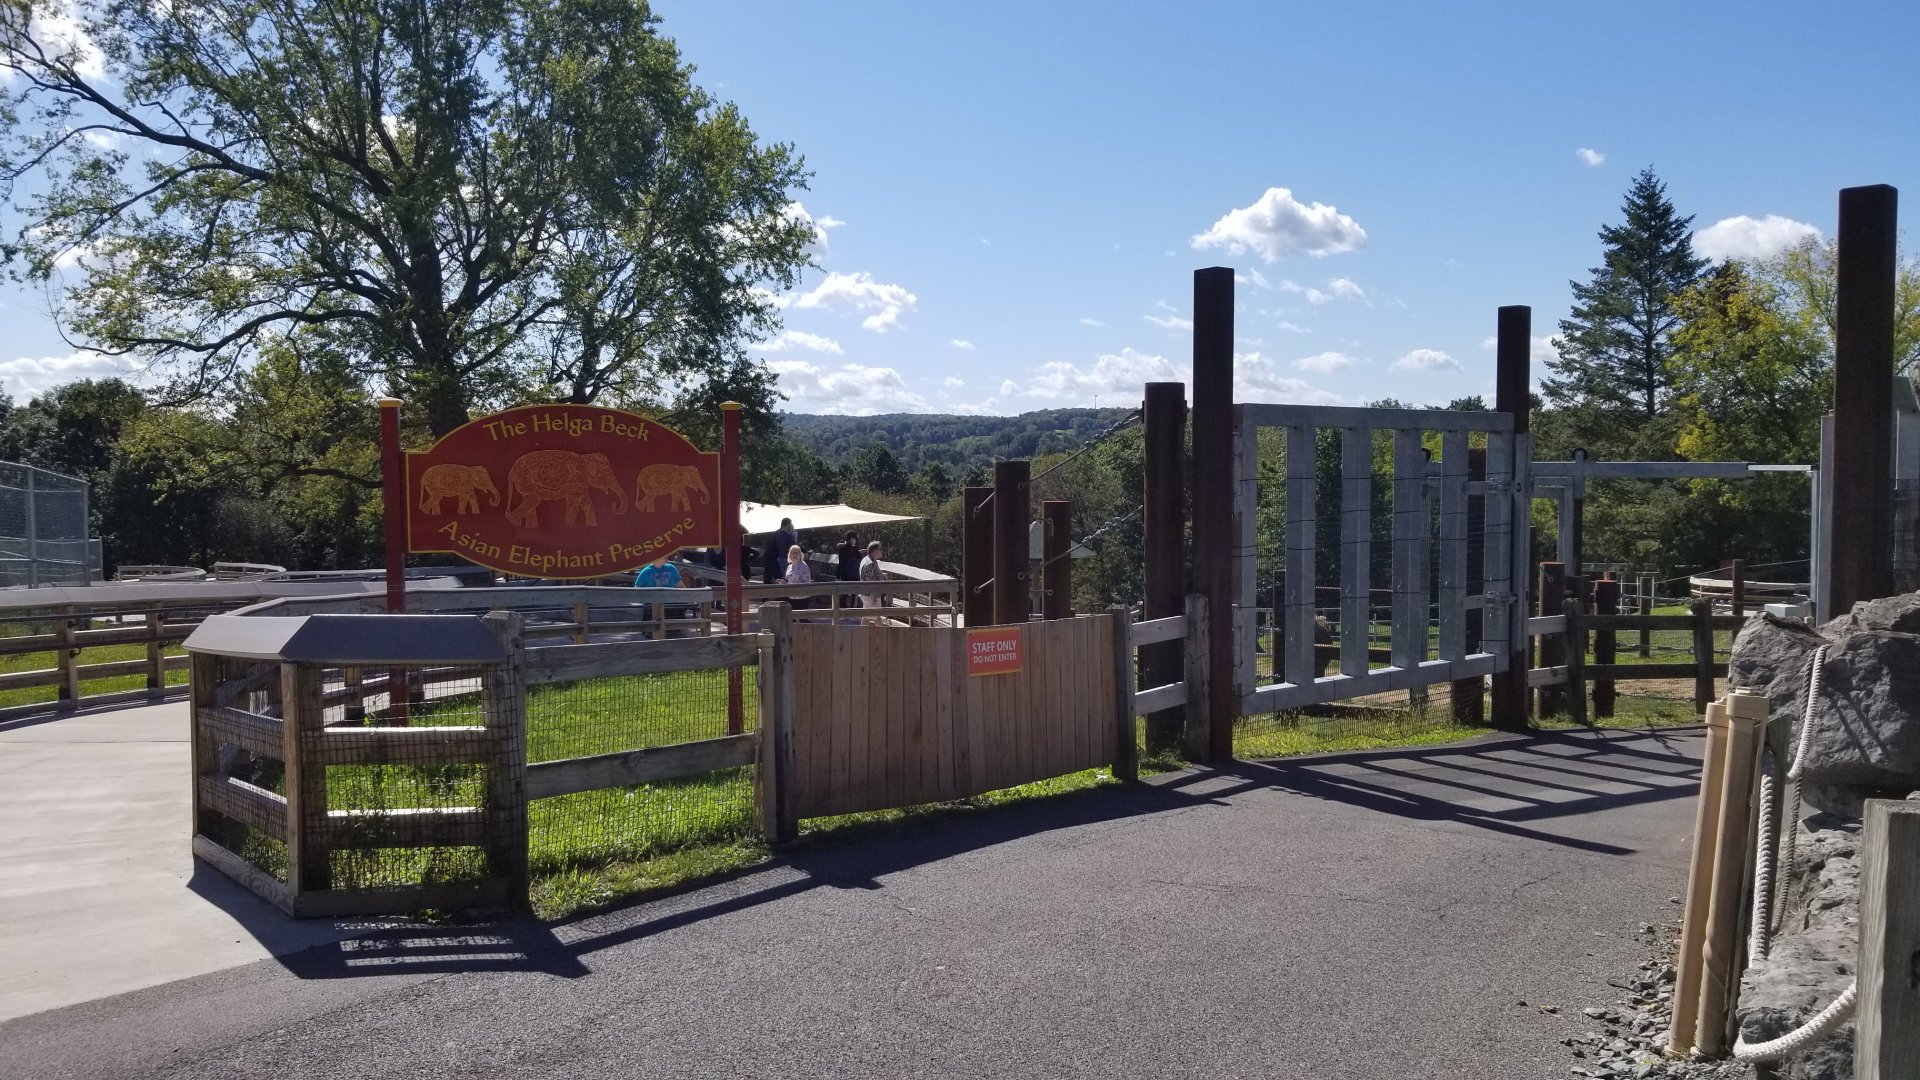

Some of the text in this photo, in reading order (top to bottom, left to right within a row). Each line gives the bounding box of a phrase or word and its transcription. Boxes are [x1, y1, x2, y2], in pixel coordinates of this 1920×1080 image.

[482, 413, 649, 441] The Helga Beck
[438, 517, 695, 572] Asian Elephant Preserve
[972, 640, 1017, 654] STAFF ONLY
[973, 652, 1017, 664] DO NOT ENTER
